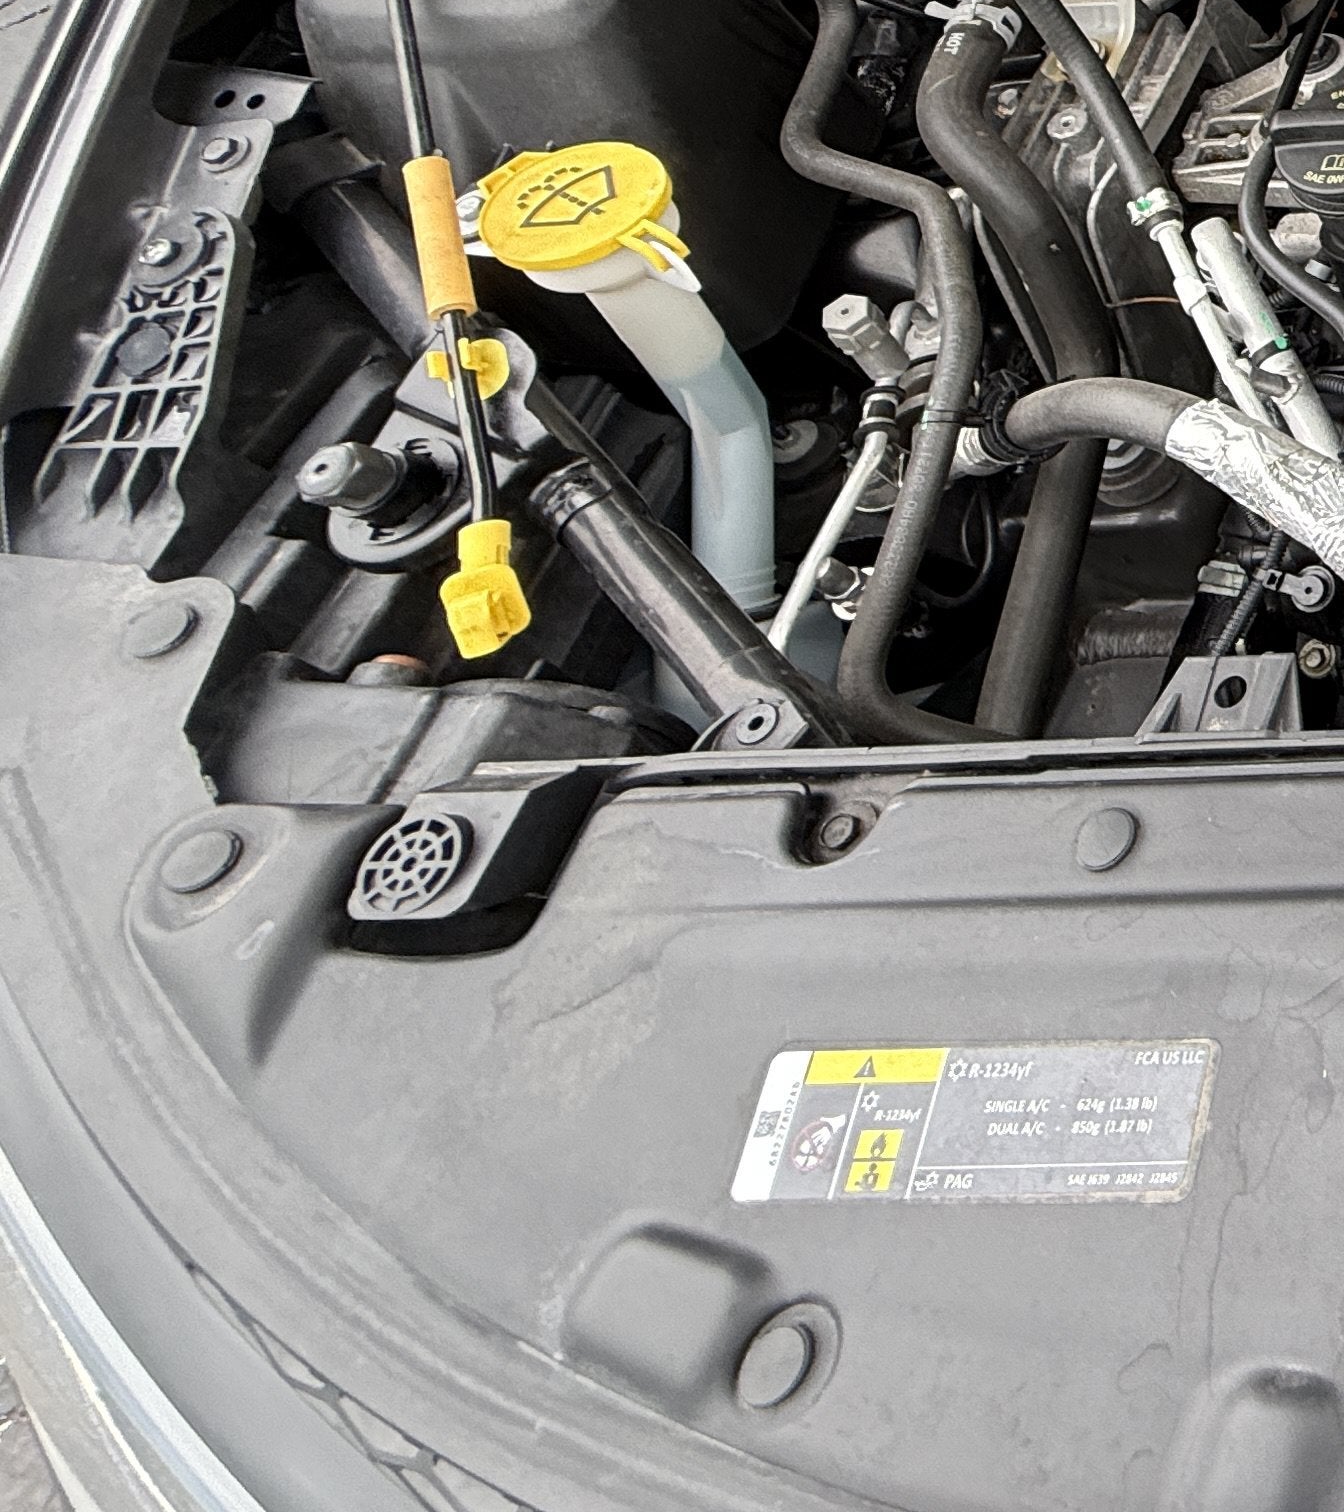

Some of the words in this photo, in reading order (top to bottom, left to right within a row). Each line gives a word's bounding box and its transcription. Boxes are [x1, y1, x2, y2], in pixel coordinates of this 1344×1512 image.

[1303, 171, 1326, 184] SAE
[1134, 1051, 1159, 1065] FCA
[1161, 1051, 1180, 1065] US
[1181, 1050, 1207, 1064] LLC
[968, 1061, 1034, 1081] R-1234yf
[984, 1099, 1026, 1114] SINGLE
[1026, 1098, 1050, 1114] A/C
[1076, 1098, 1107, 1114] 624g
[1141, 1096, 1159, 1113] lb)
[873, 1108, 923, 1124] R-1234yf
[987, 1122, 1020, 1136] DUAL
[1022, 1121, 1045, 1137] A/C
[1070, 1121, 1101, 1137] 850g
[1136, 1119, 1153, 1134] lb)
[943, 1173, 974, 1189] PAG
[1067, 1174, 1087, 1186] SAE
